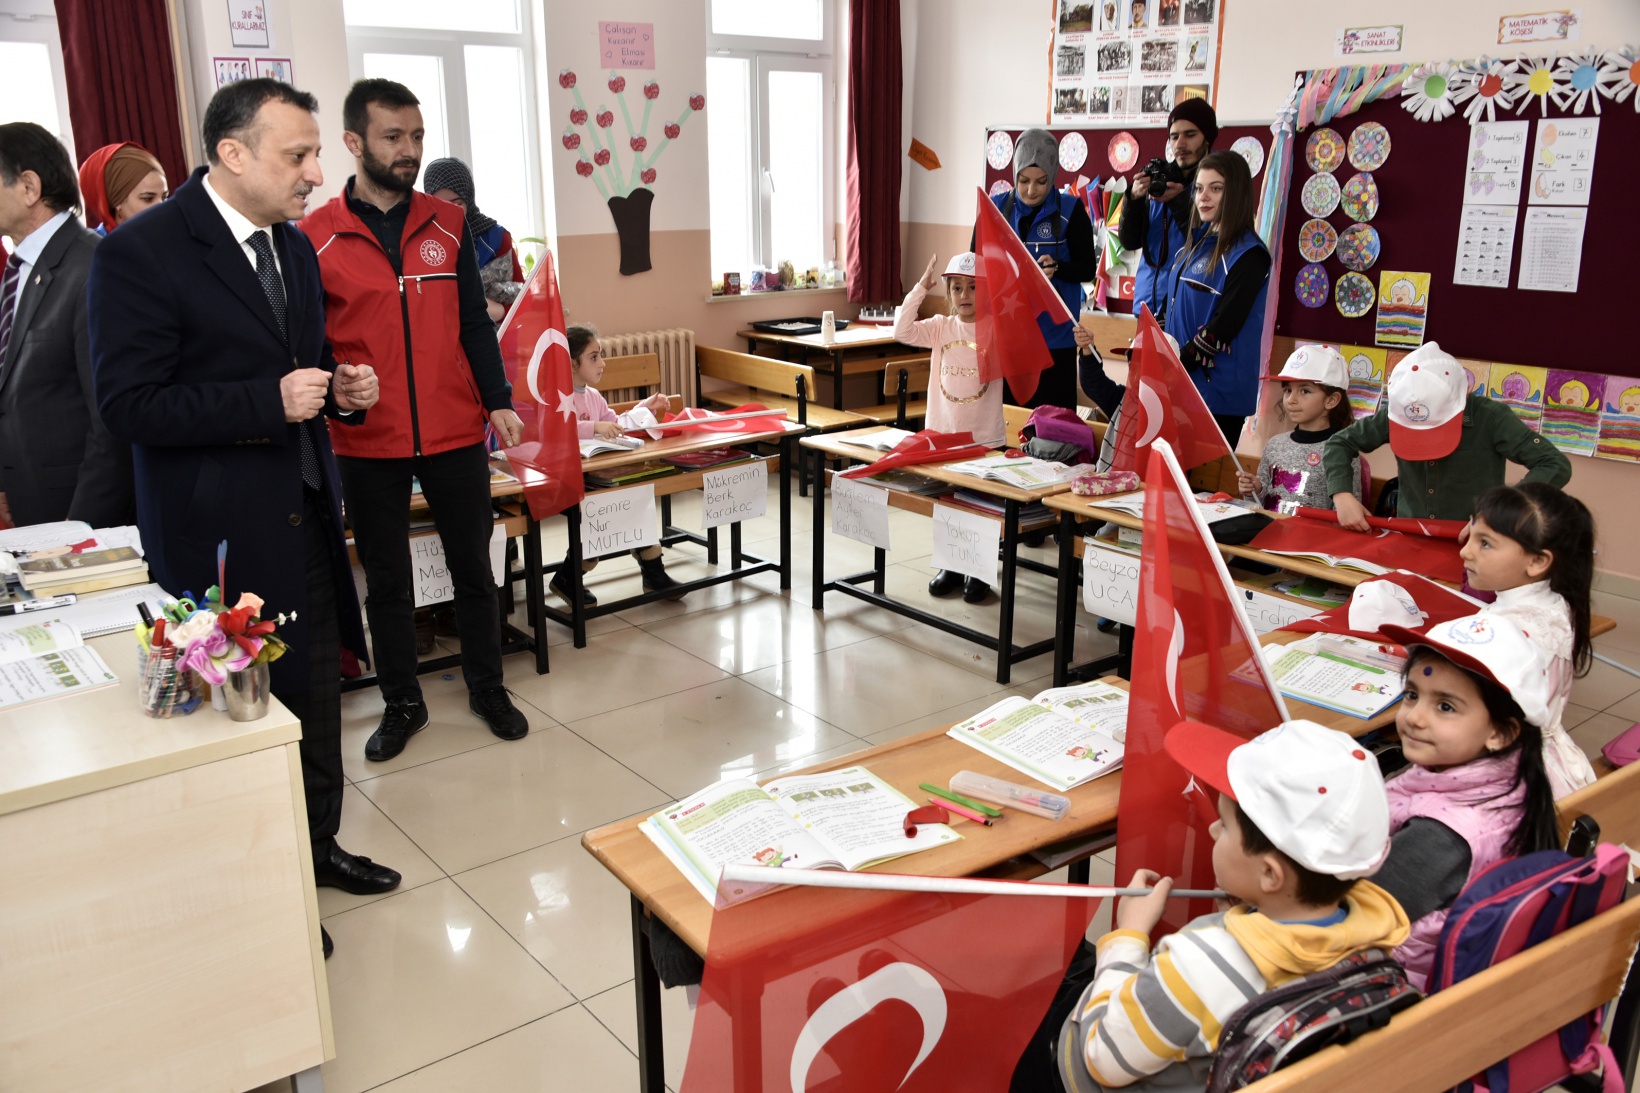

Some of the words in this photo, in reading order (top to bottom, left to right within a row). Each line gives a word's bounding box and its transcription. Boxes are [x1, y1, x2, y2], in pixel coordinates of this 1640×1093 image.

[1509, 17, 1548, 28] MATEMATİK
[1367, 31, 1386, 39] SANAT
[707, 488, 734, 505] Berk
[585, 499, 631, 518] Cemre
[589, 519, 611, 535] Nur
[588, 528, 643, 554] MUTLU
[1089, 549, 1139, 582] Beyza
